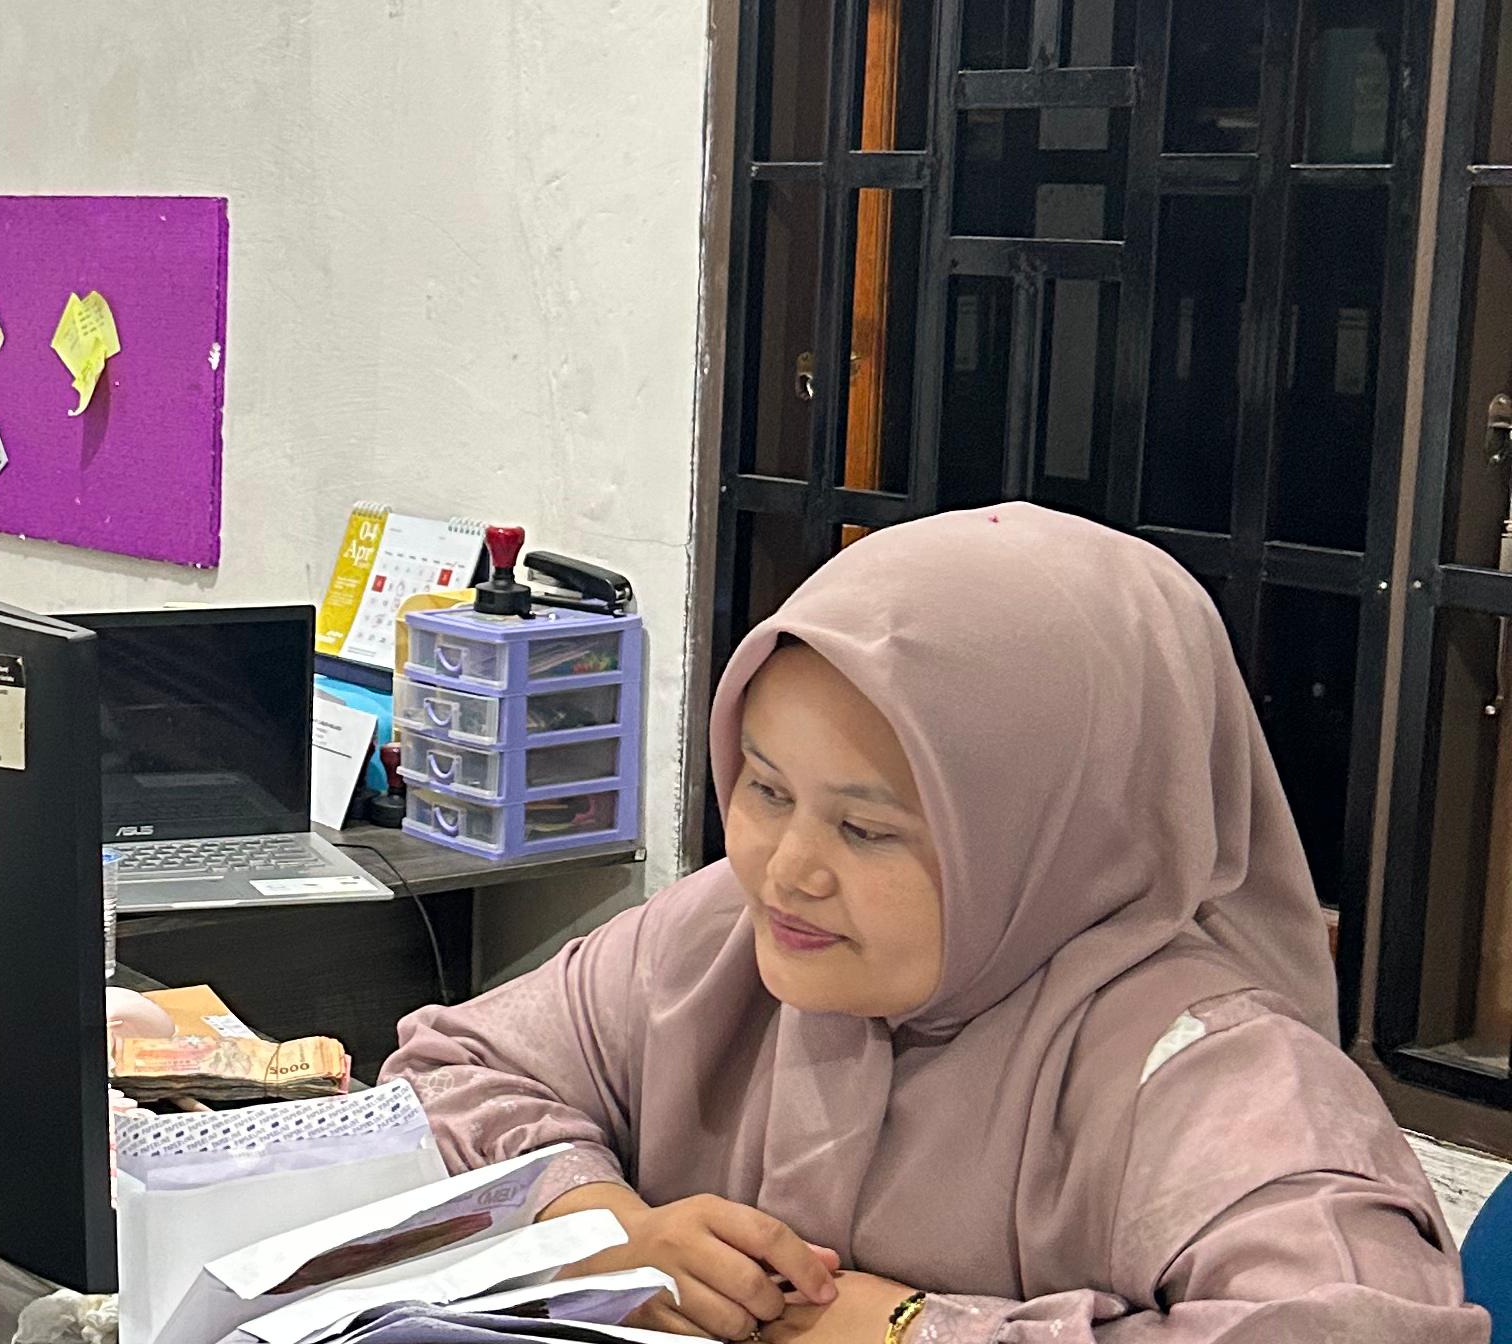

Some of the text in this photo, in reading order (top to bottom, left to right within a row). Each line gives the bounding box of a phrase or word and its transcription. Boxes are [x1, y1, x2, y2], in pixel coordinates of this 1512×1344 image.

[360, 520, 380, 540] 04
[343, 539, 375, 567] Apr
[116, 825, 154, 836] ASUS
